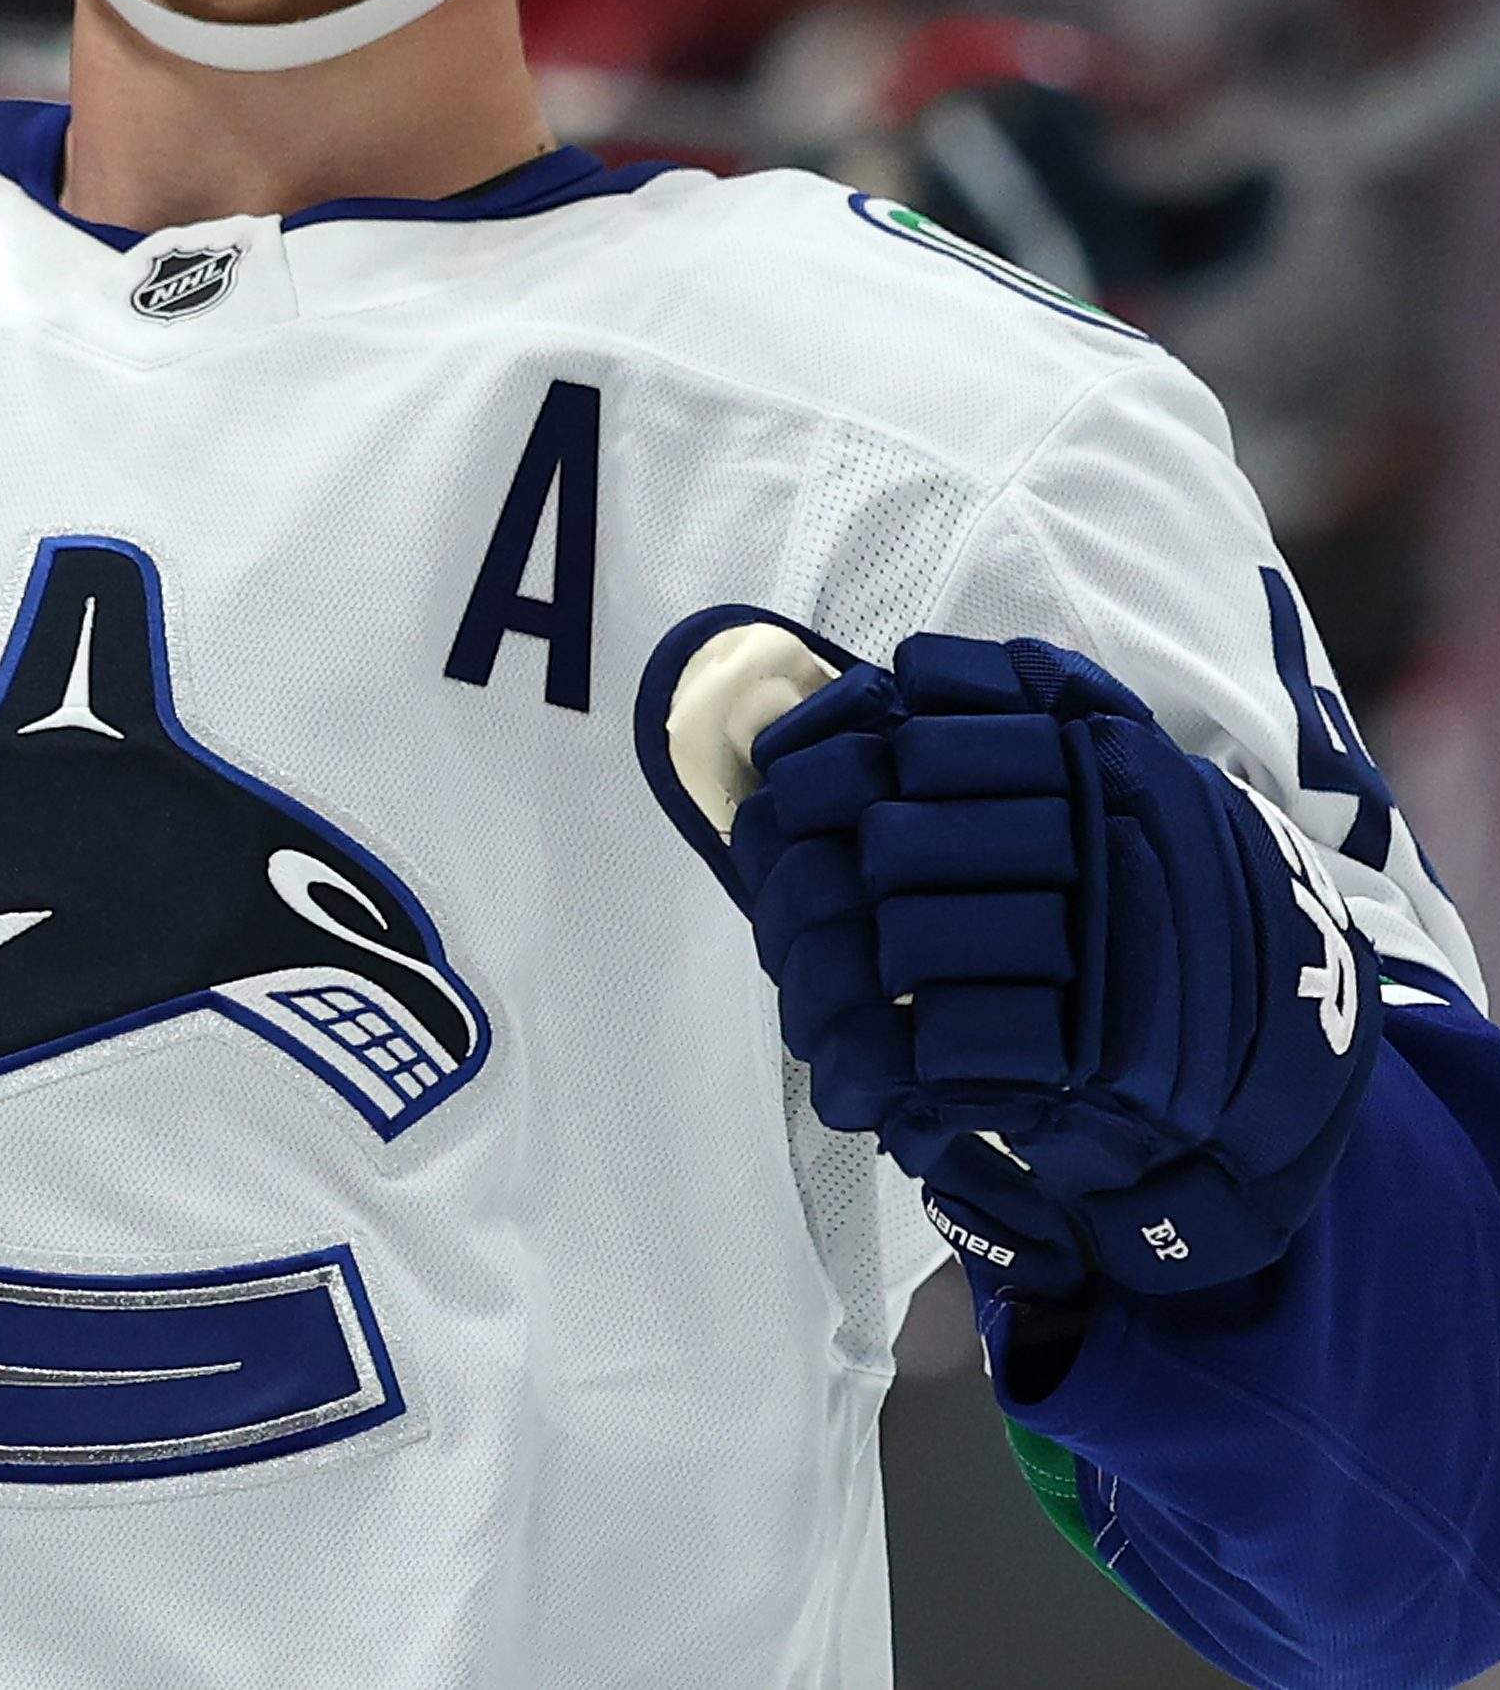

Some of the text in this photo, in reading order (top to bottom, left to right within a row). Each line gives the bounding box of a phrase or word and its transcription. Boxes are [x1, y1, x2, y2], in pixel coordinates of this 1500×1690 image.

[150, 260, 223, 307] NHL
[444, 379, 600, 713] A
[1142, 1218, 1190, 1260] EP
